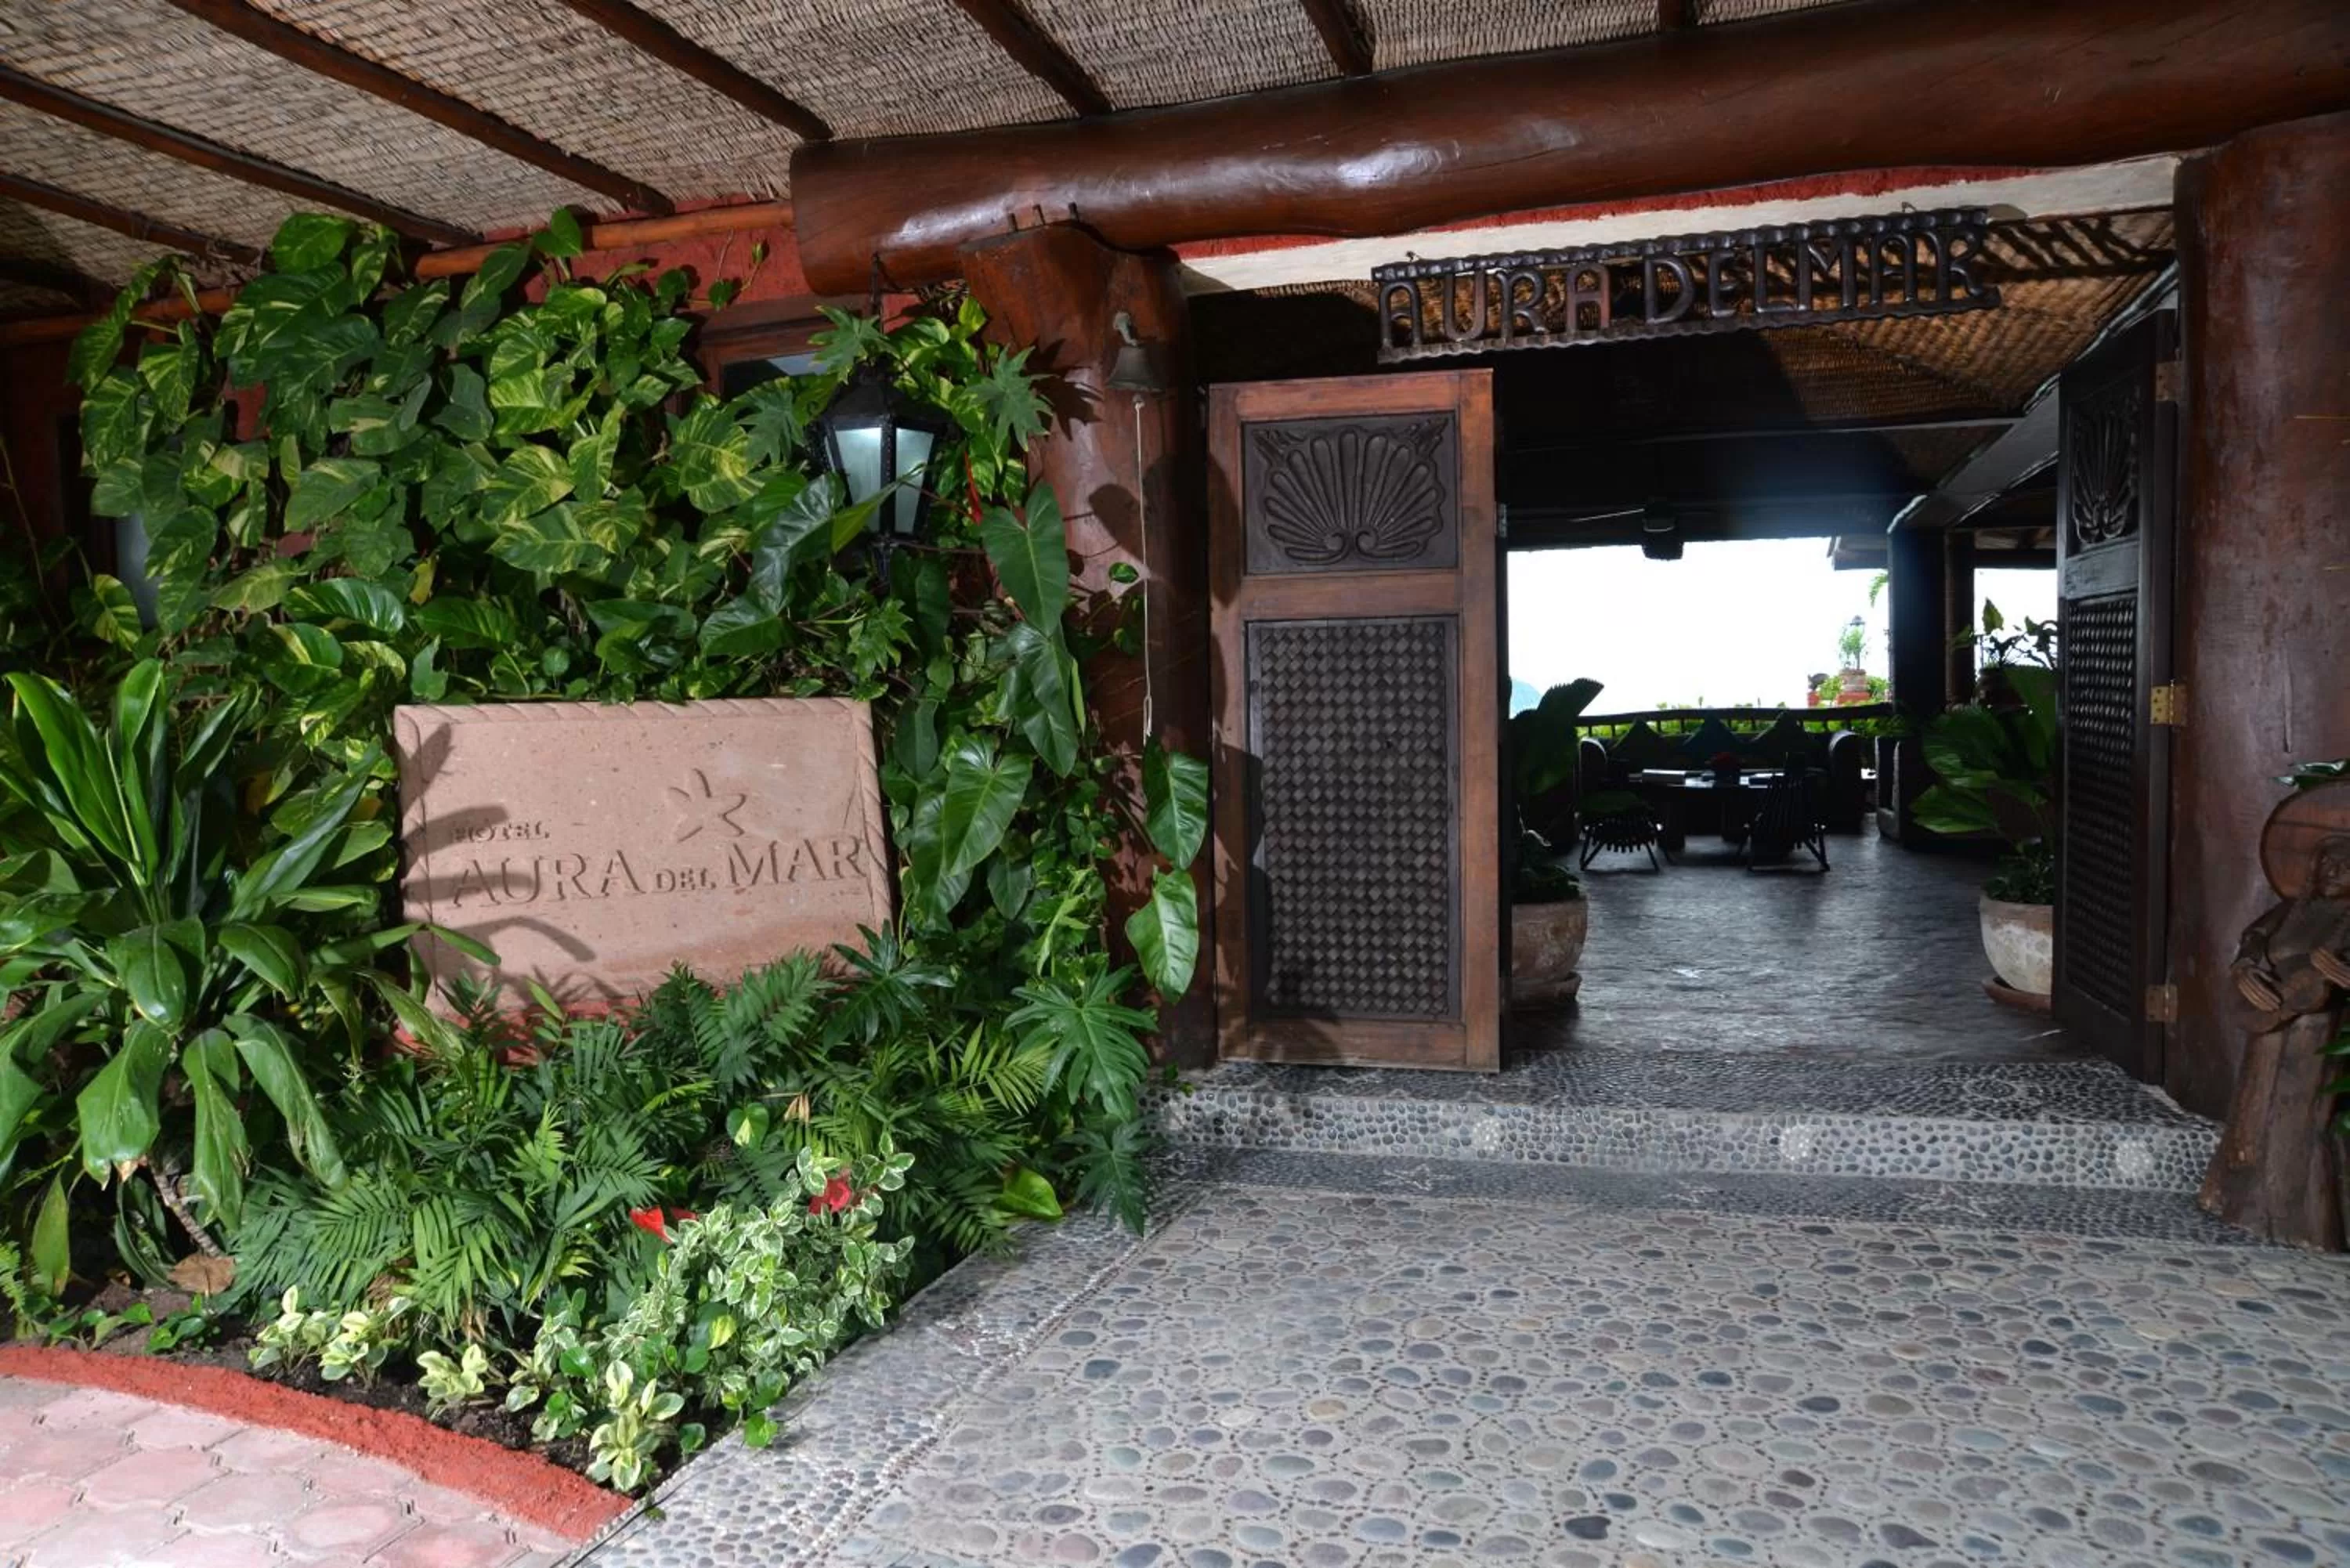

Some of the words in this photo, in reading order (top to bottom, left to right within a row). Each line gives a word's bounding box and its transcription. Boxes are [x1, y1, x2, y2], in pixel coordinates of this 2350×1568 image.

[1378, 262, 1611, 352] AURA
[451, 821, 549, 842] HOTEL
[453, 848, 647, 908] AURA
[656, 867, 717, 892] DEL
[727, 836, 867, 888] MAR
